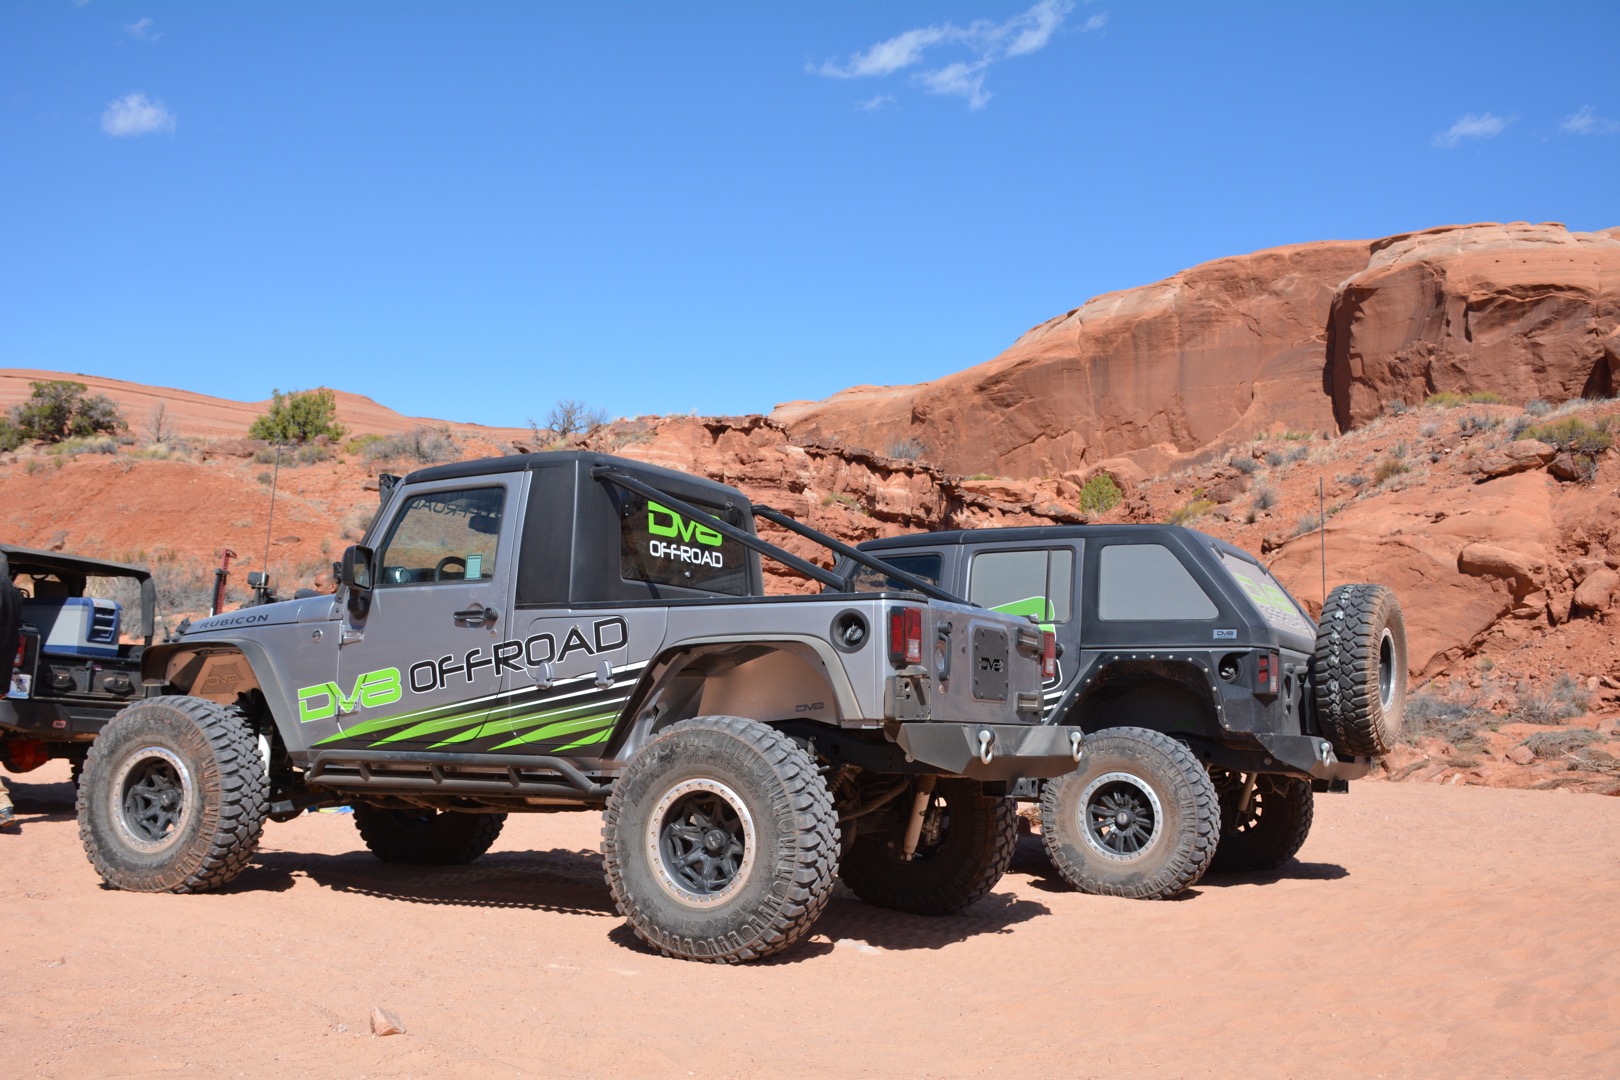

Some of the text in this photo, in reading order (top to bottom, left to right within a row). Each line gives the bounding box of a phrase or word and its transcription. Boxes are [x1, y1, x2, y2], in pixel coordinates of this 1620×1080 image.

[650, 540, 723, 568] OFFROAD
[200, 614, 268, 629] RUBICON
[298, 617, 629, 723] DV8 OFFROAD
[979, 656, 1004, 673] DV8
[795, 702, 825, 712] DV8
